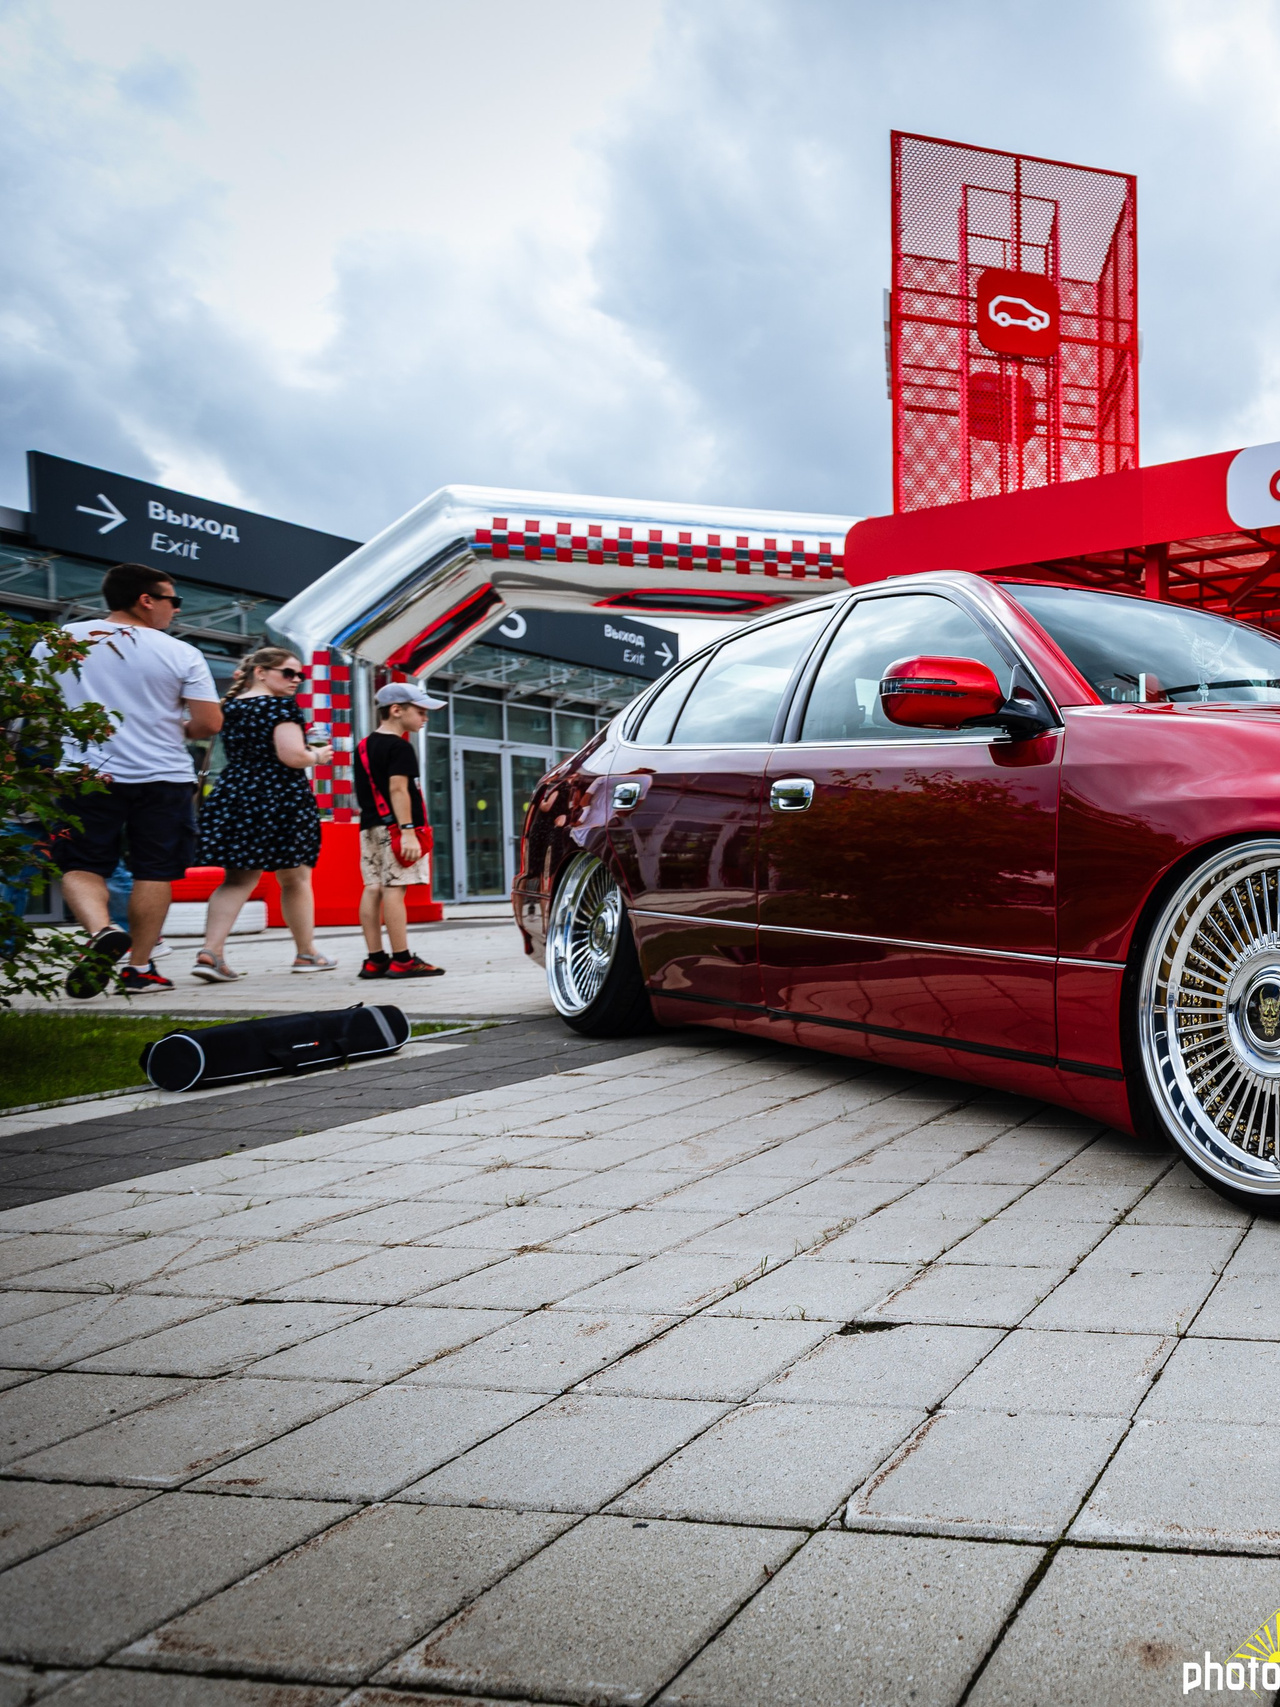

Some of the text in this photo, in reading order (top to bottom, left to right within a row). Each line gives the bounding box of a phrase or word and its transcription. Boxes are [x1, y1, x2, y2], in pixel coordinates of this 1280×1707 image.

[148, 500, 240, 543] Выход
[150, 531, 201, 560] Exit
[604, 623, 645, 648] Выход
[623, 649, 645, 665] Exit
